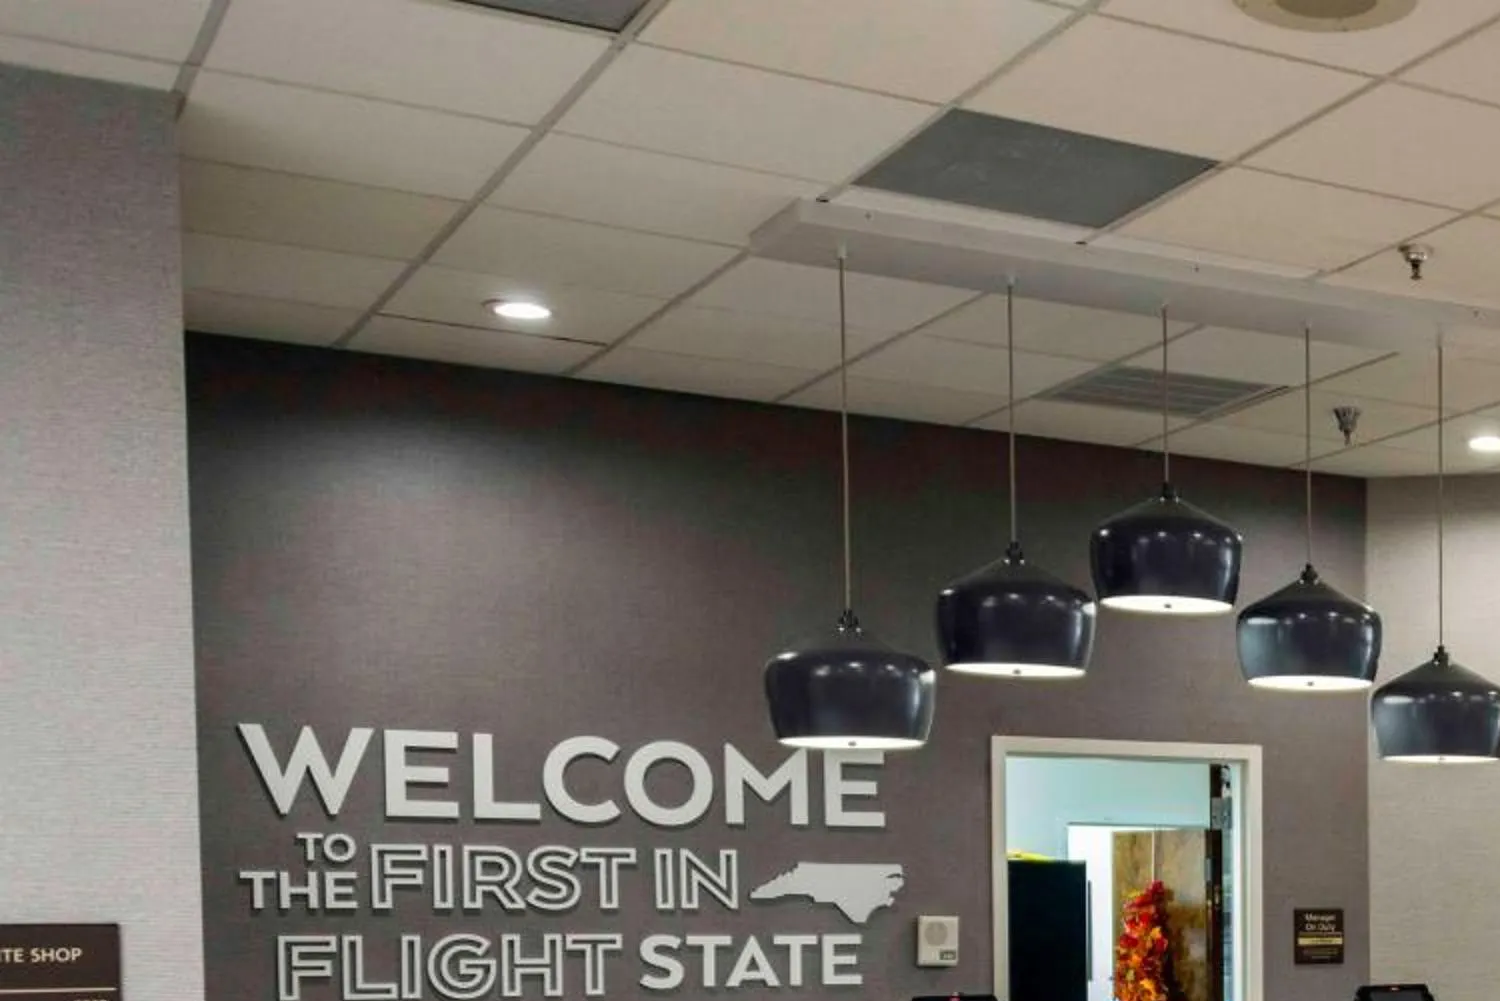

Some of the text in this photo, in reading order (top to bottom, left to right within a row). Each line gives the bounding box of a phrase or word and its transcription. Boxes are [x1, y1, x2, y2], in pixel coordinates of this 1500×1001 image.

[236, 723, 886, 827] WELCOME
[297, 832, 356, 862] TO
[239, 843, 739, 911] THE FIRST IN
[30, 947, 82, 963] SHOP
[639, 934, 863, 989] STATE
